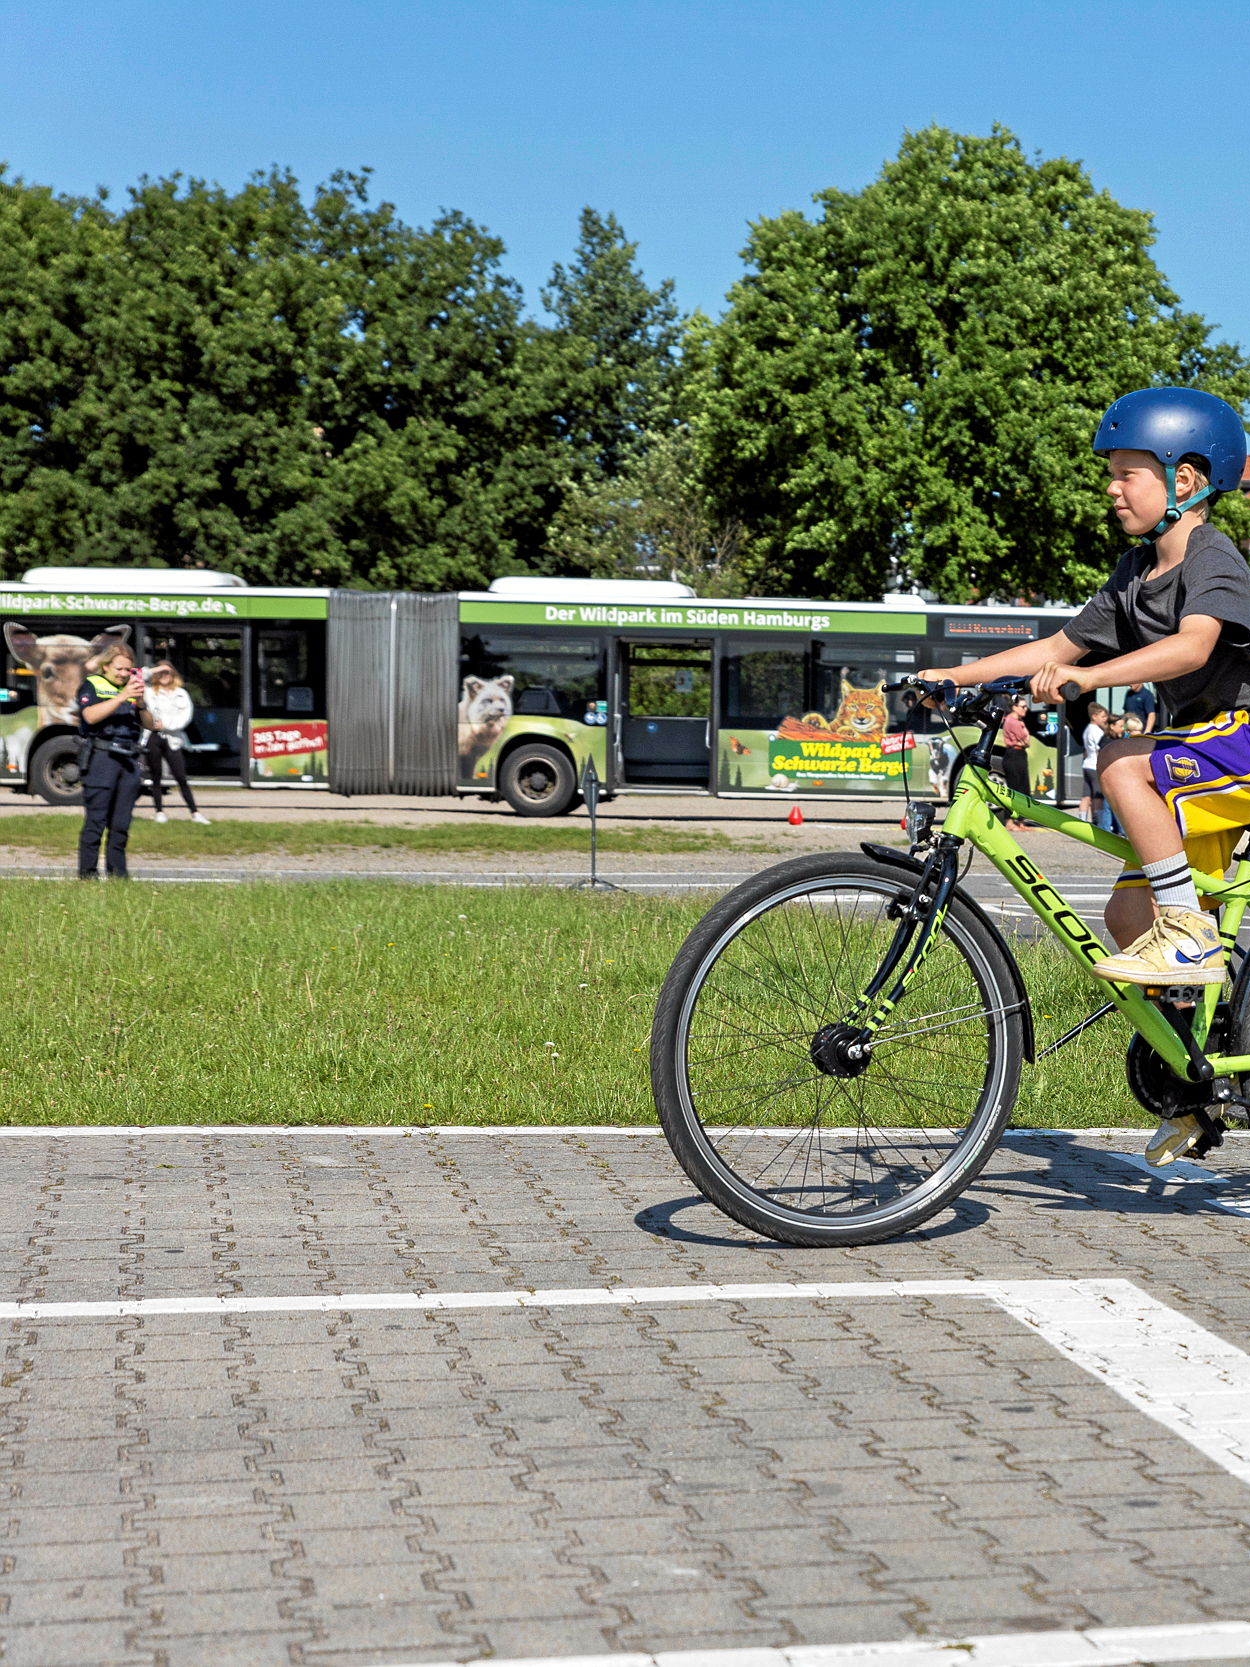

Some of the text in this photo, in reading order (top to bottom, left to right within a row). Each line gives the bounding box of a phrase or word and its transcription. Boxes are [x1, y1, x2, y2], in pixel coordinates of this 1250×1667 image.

[0, 593, 224, 616] ildpark-Schwarze-Berge.de
[545, 605, 831, 631] Der Wildpark im Süden Hamburgs
[800, 742, 882, 760] Wildpark
[772, 755, 910, 776] Schwarze Berge
